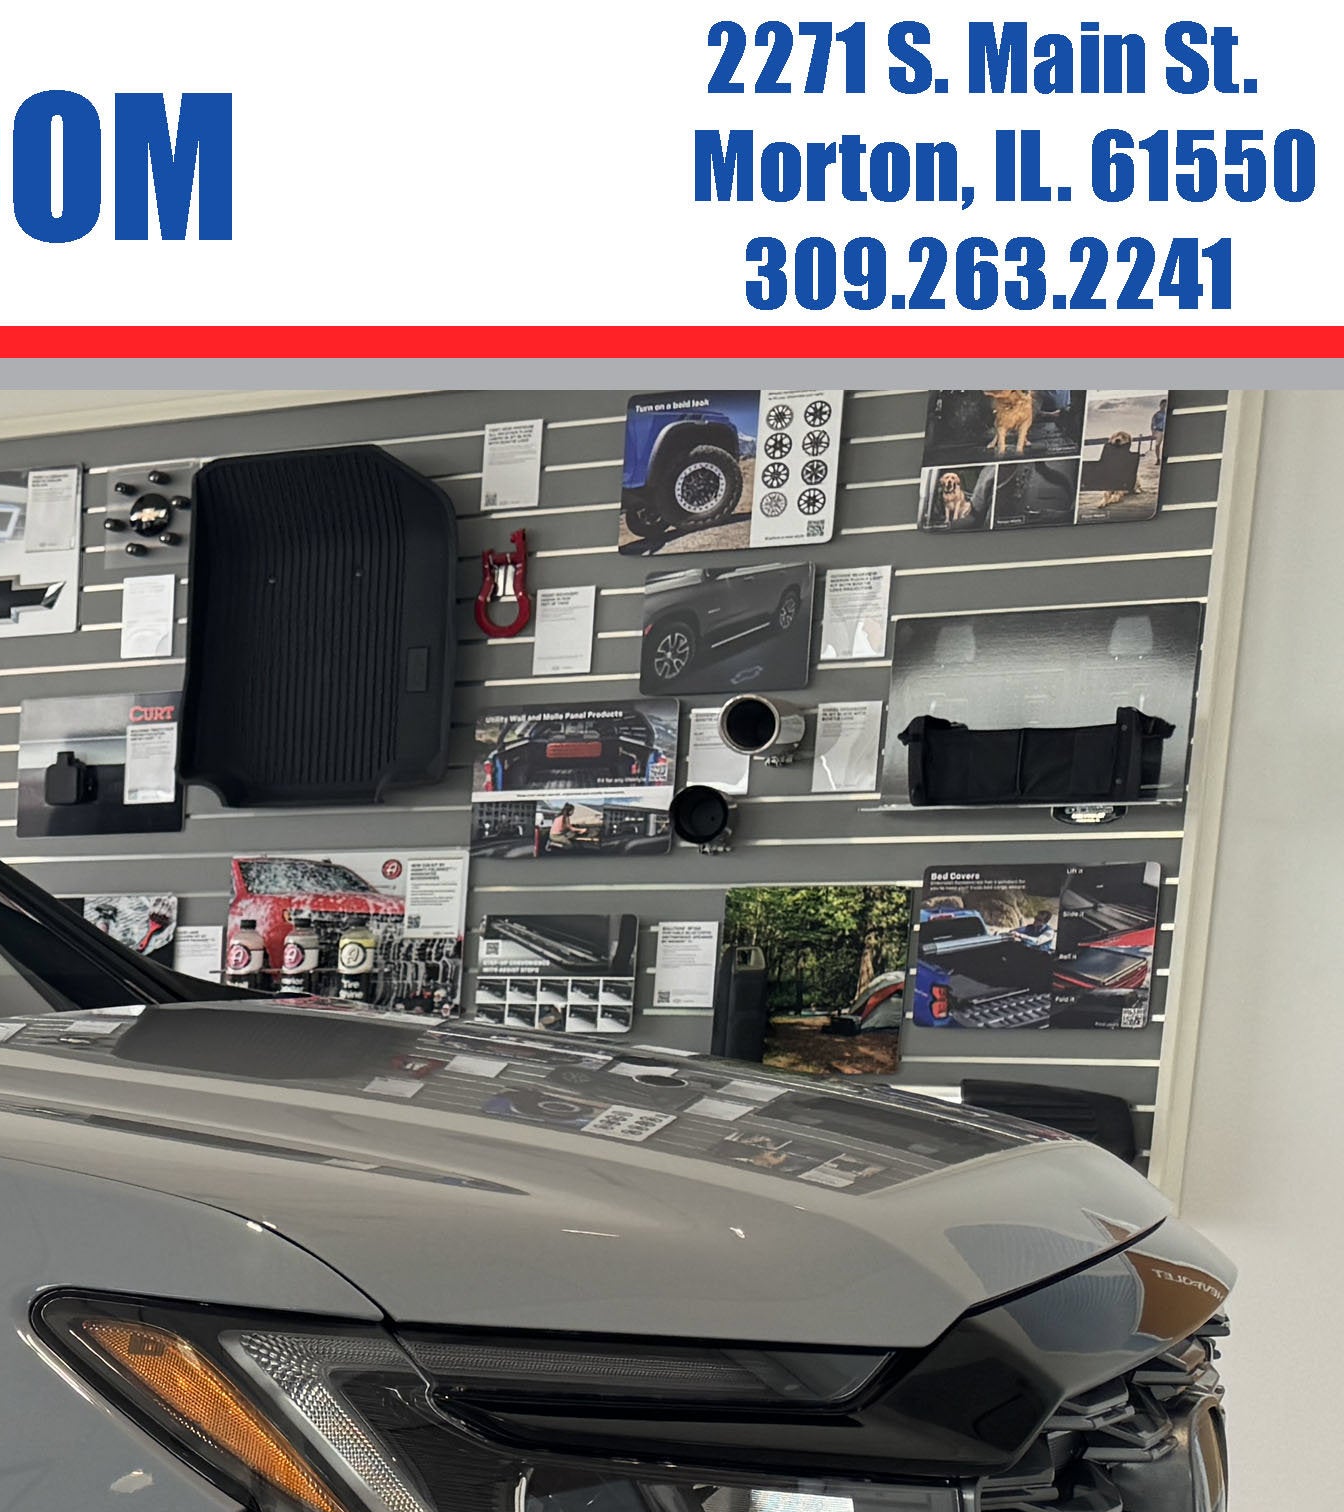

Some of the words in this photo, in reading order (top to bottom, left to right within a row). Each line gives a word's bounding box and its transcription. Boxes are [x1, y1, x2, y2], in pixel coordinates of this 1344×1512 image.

[129, 705, 175, 722] CURT
[587, 710, 623, 719] Products
[931, 872, 949, 880] Bed
[950, 871, 980, 880] Covers
